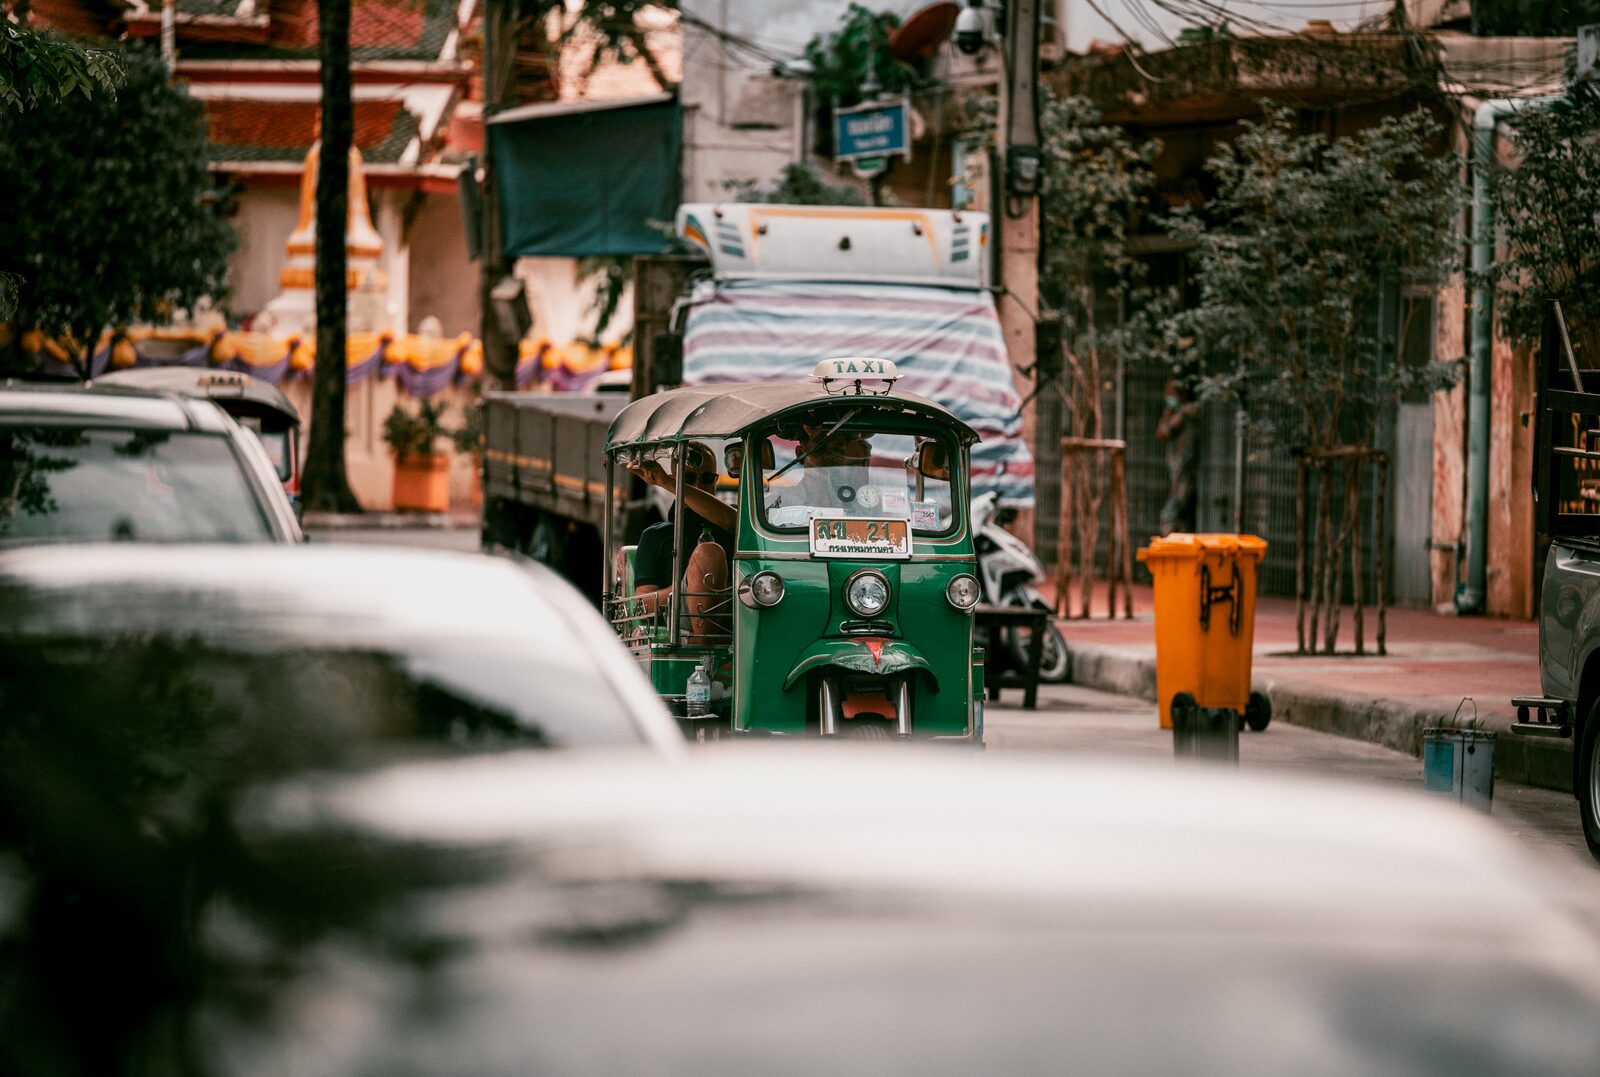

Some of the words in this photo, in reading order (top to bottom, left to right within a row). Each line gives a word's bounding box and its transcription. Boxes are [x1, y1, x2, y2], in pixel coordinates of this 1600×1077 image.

[833, 361, 885, 374] TAXI
[866, 521, 889, 541] 21
[829, 545, 894, 553] กรงเทพมหานคร
